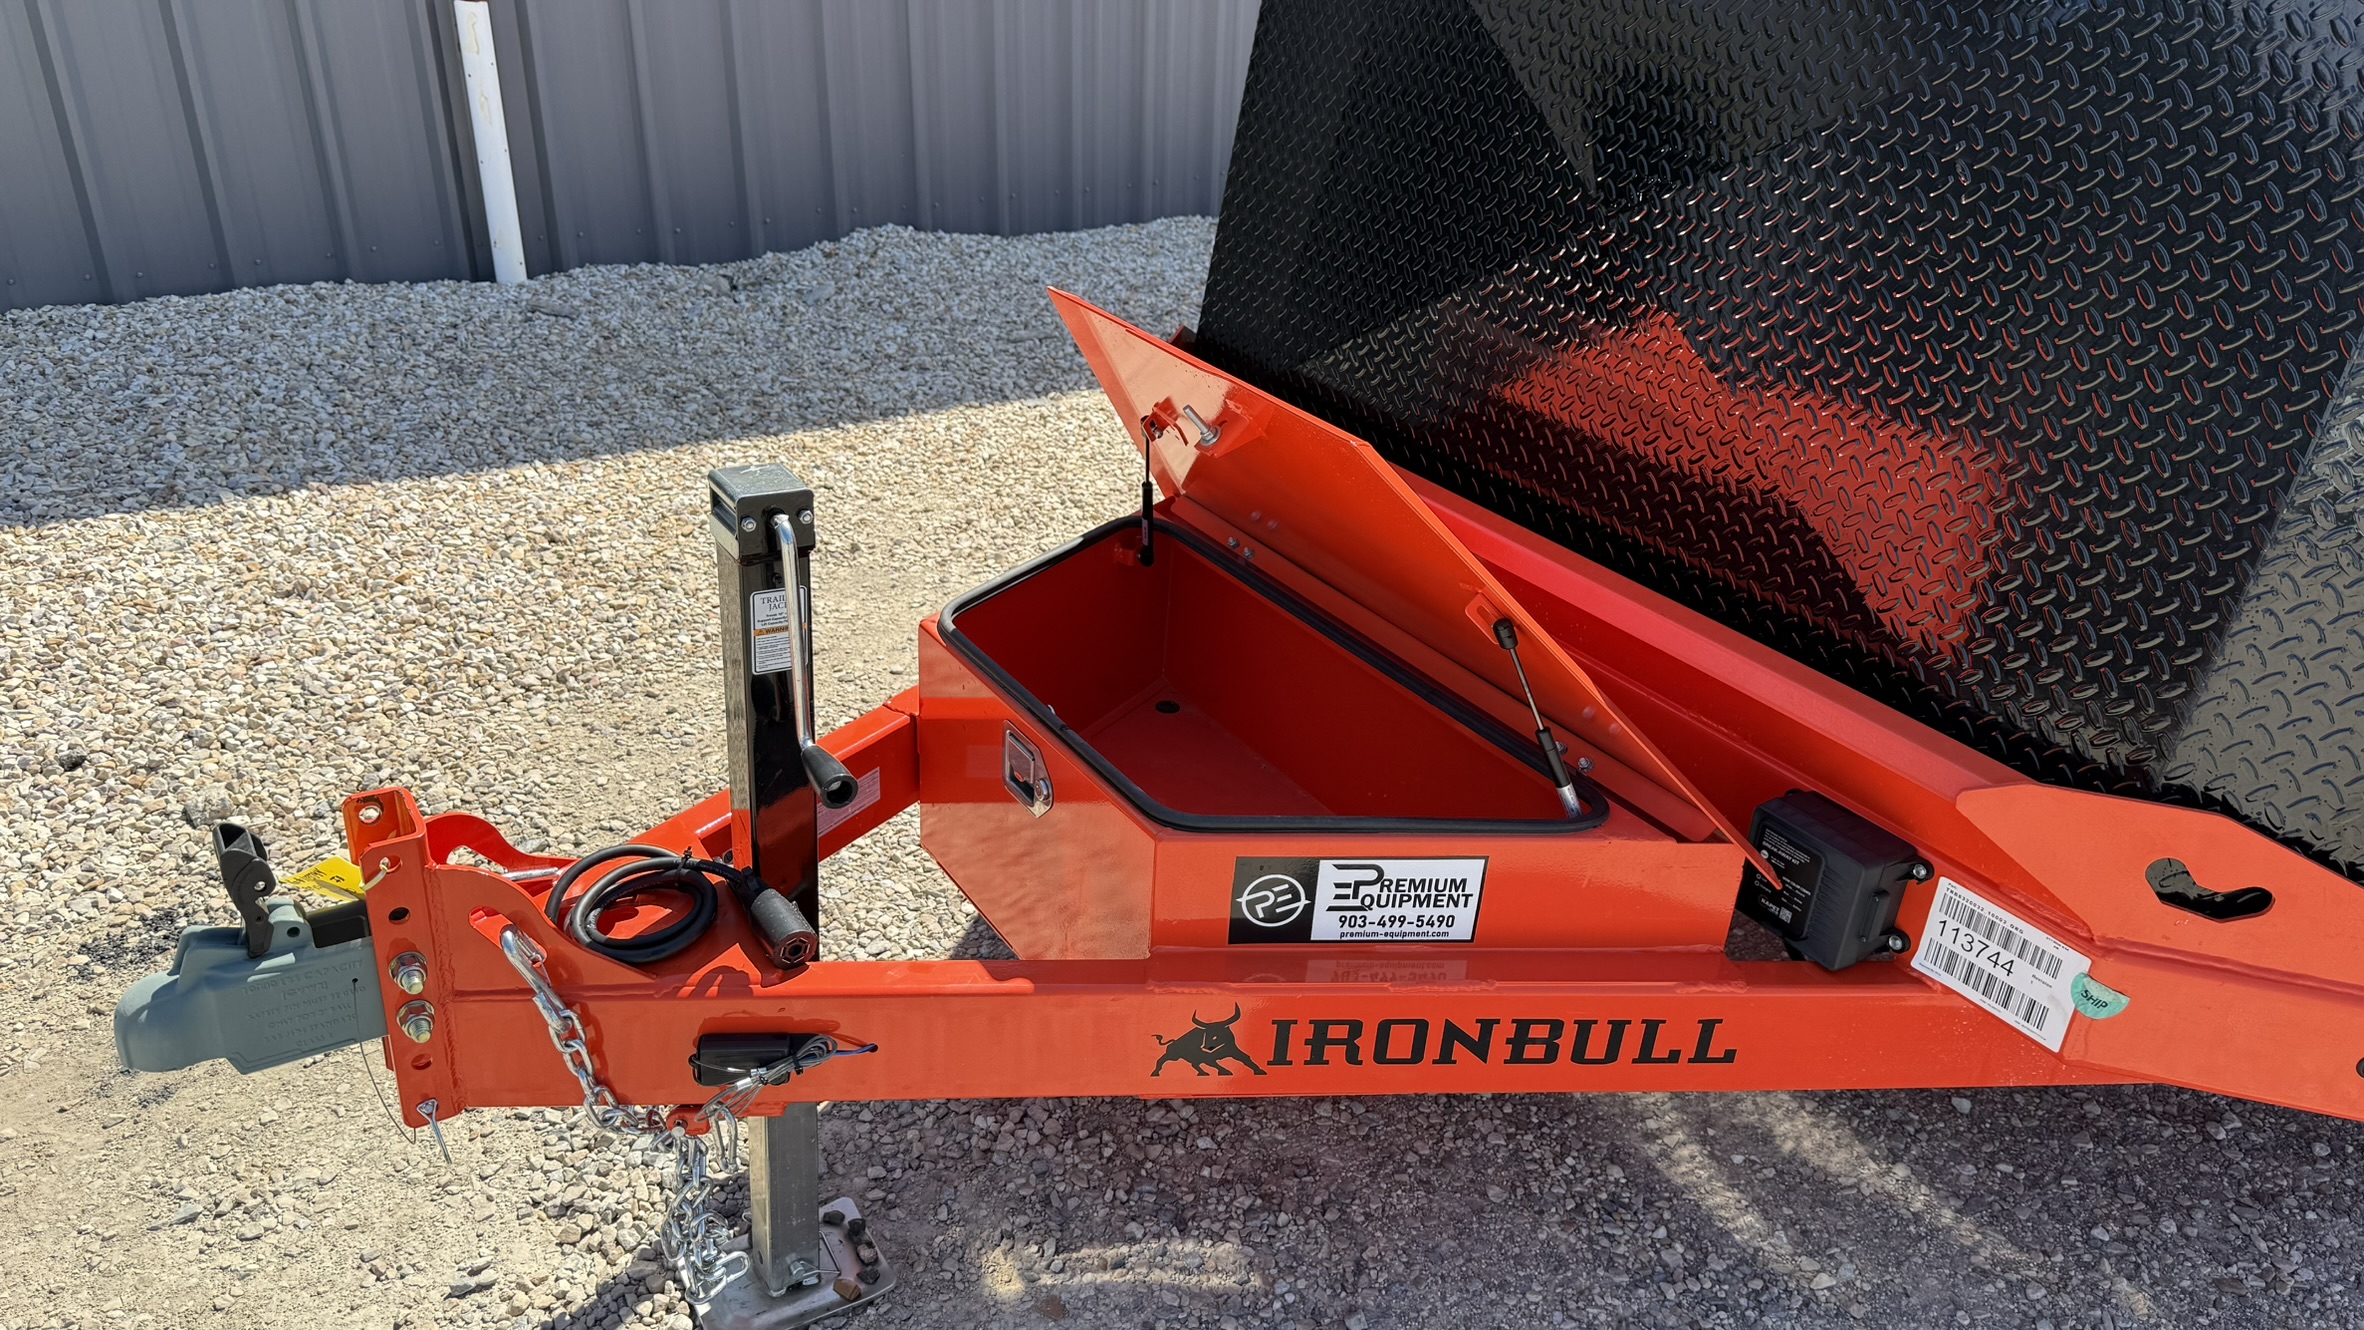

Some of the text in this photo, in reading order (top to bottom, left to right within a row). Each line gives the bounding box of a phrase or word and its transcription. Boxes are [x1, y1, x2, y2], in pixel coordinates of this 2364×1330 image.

[1338, 914, 1455, 929] 903-499-5490
[1340, 929, 1450, 940] premium-equipment.com
[1938, 919, 2015, 978] 113744
[2081, 989, 2108, 1009] SHIP
[1267, 1017, 1737, 1066] IRONBULL
